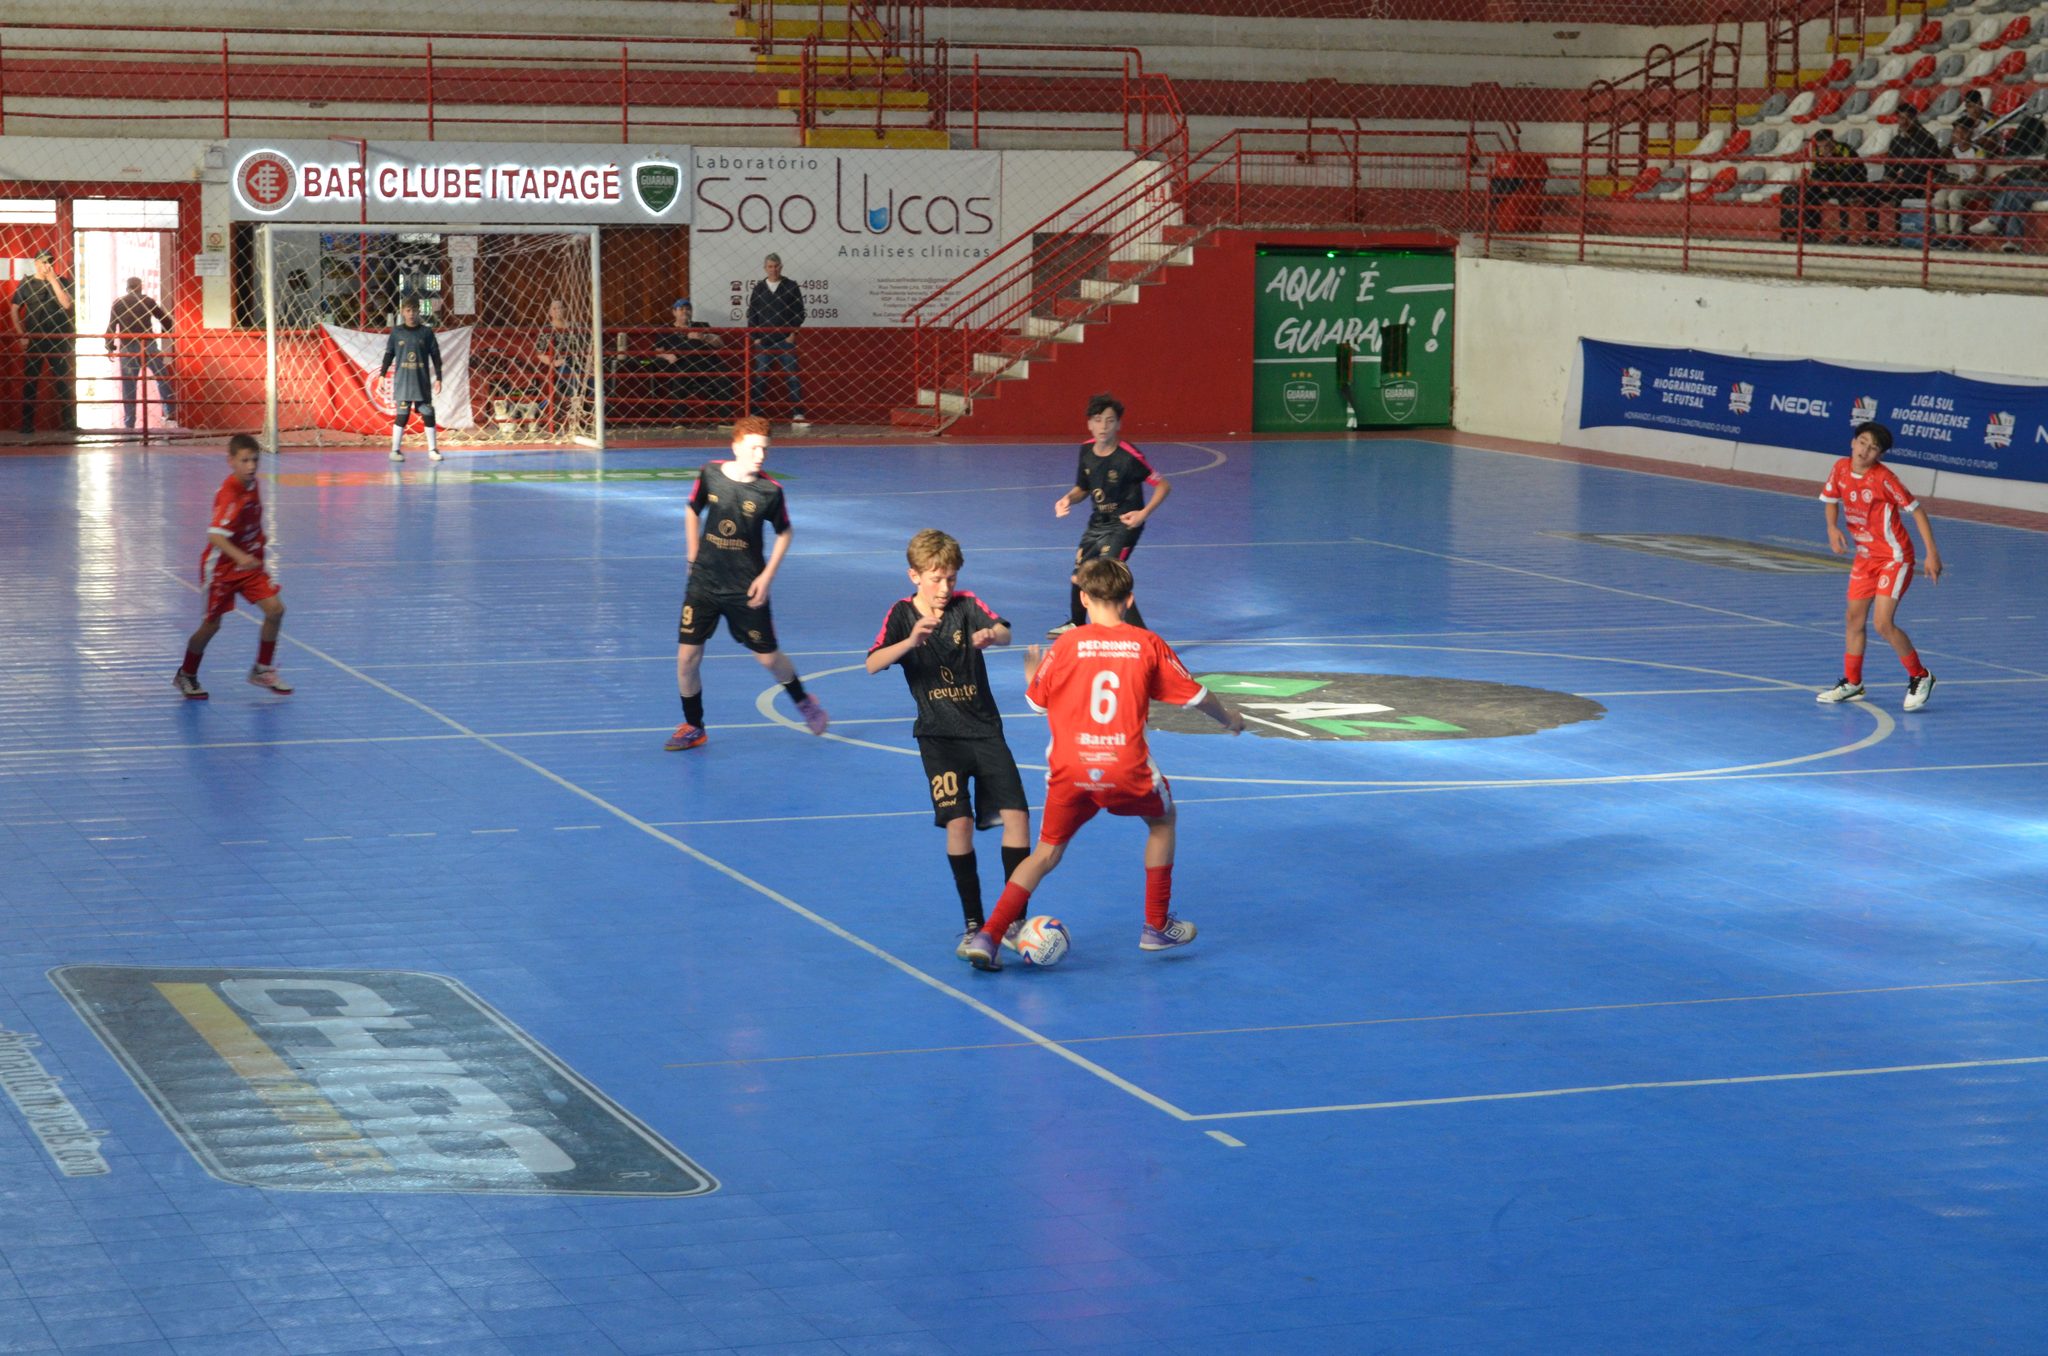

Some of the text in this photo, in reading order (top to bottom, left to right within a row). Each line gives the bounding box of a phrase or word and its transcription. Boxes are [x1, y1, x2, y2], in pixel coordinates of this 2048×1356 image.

[696, 155, 818, 170] Laboratório
[304, 163, 620, 199] BAR CLUBE ITAPAGÉ
[640, 175, 674, 186] GUARANI
[838, 245, 991, 258] Análises clínicas
[1356, 261, 1380, 302] É
[1669, 367, 1705, 380] LIGA SUL
[1653, 378, 1718, 397] RIOGRANDENSE
[1662, 391, 1704, 408] DE FUTSAL
[1770, 394, 1830, 418] NEDEL
[1911, 395, 1954, 411] LIGA SUL
[1891, 408, 1971, 429] RIOGRANDENSE
[1901, 424, 1952, 442] DE FUTSAL
[1849, 490, 1857, 502] 9
[681, 605, 693, 626] 9
[1089, 670, 1121, 725] 6
[1080, 732, 1126, 746] Barril
[931, 771, 959, 801] 20
[220, 978, 577, 1173] CHICO
